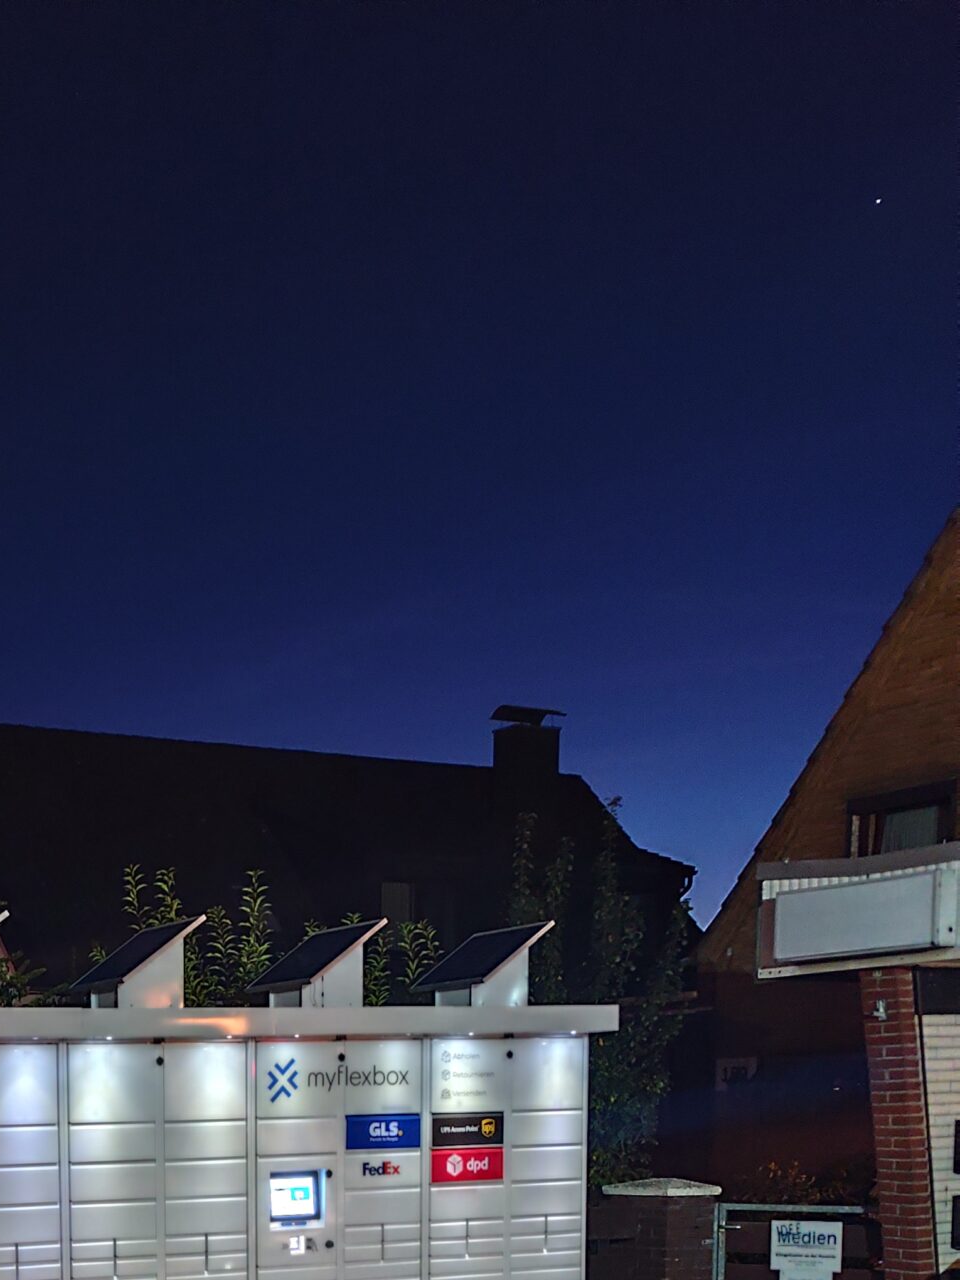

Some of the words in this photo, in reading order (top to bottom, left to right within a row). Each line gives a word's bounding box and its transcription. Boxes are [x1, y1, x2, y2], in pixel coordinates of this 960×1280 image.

[307, 1064, 409, 1092] myflexbox
[362, 1161, 400, 1176] FedEx
[466, 1156, 489, 1174] dpd
[777, 1231, 837, 1246] Medien
